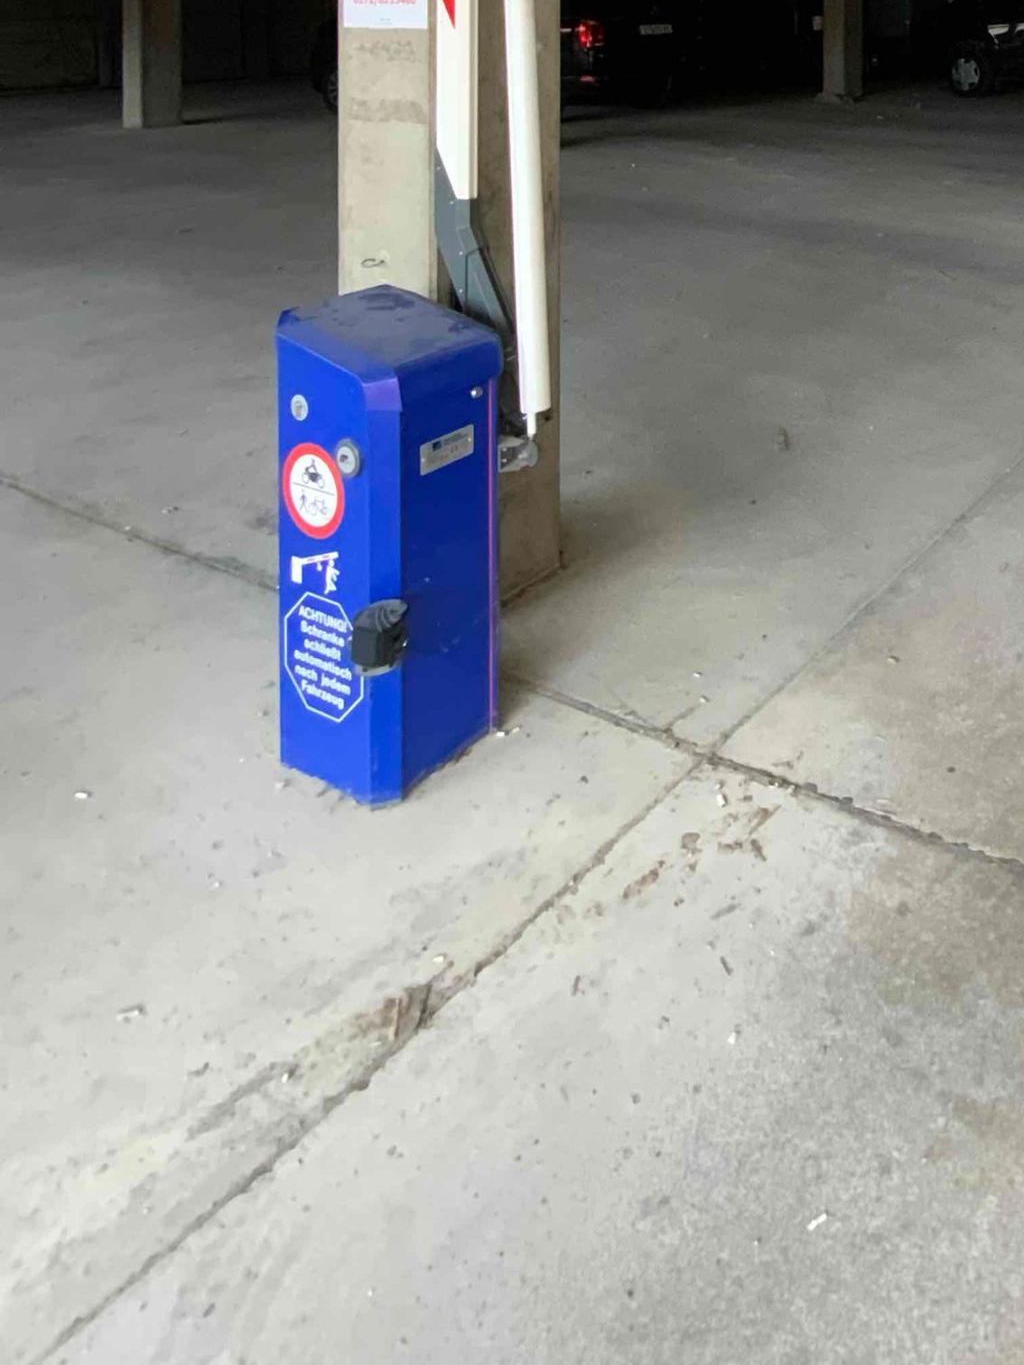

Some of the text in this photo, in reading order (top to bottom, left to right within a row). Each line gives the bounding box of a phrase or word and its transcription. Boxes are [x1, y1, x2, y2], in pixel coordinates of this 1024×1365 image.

[301, 620, 345, 647] Schranke
[294, 649, 352, 681] automatisch
[295, 665, 351, 696] nach jedem
[302, 679, 345, 710] Fahrzeug
